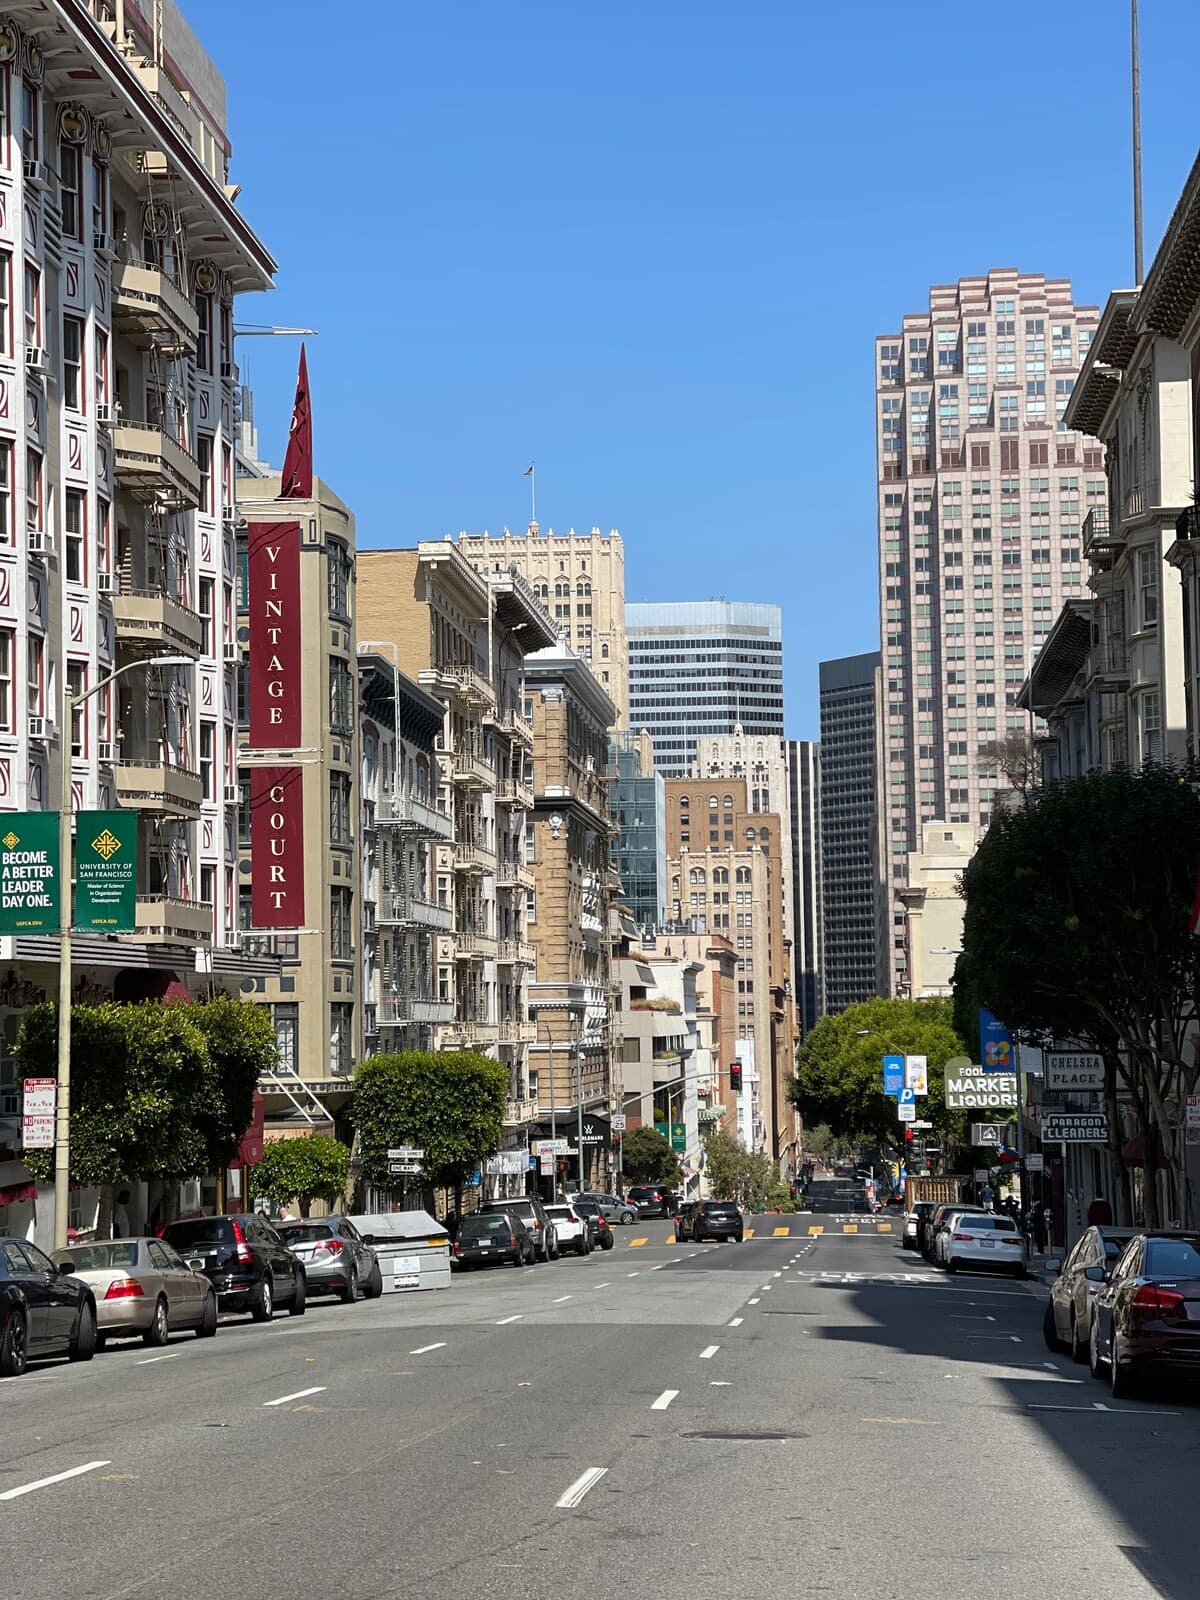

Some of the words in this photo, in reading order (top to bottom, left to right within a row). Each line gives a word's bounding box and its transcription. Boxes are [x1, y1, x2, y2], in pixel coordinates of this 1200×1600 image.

[265, 546, 284, 724] VINTAGE
[269, 786, 287, 909] COURT
[2, 851, 48, 864] BECOME
[2, 867, 12, 879] A
[12, 866, 54, 879] BETTER
[2, 881, 44, 893] LEADER
[2, 895, 25, 908] DAY
[26, 894, 53, 907] ONE.
[1051, 1057, 1100, 1069] CHELSEA
[1053, 1074, 1097, 1083] PLACE
[25, 1085, 34, 1093] NO
[24, 1117, 33, 1126] NO
[1052, 1118, 1101, 1127] PARAGON
[1047, 1128, 1108, 1138] CLEANERS
